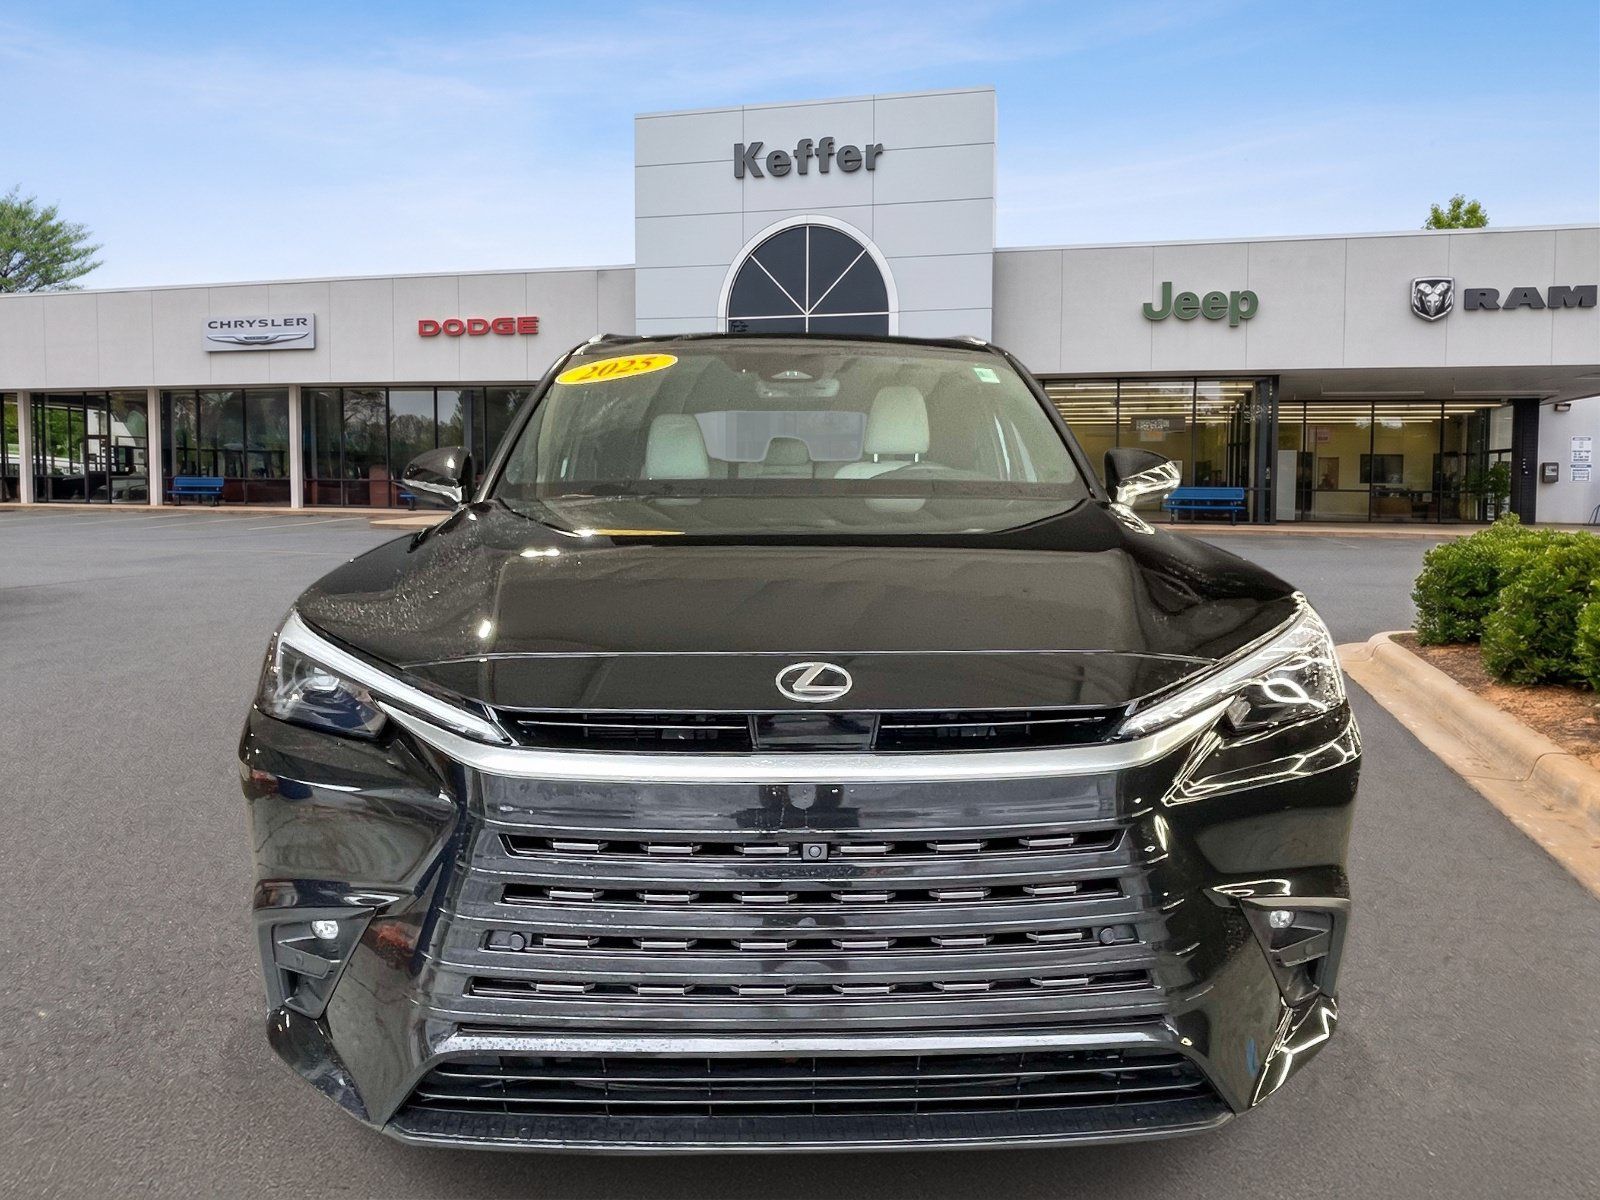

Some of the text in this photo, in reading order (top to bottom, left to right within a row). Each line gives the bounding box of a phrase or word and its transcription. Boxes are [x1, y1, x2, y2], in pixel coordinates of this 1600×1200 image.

[734, 137, 883, 178] Keffer
[1143, 281, 1259, 327] Jeep
[1464, 285, 1598, 310] RAM
[207, 317, 308, 329] CHRYSLER
[418, 317, 539, 336] DODGE
[577, 356, 657, 380] 2025
